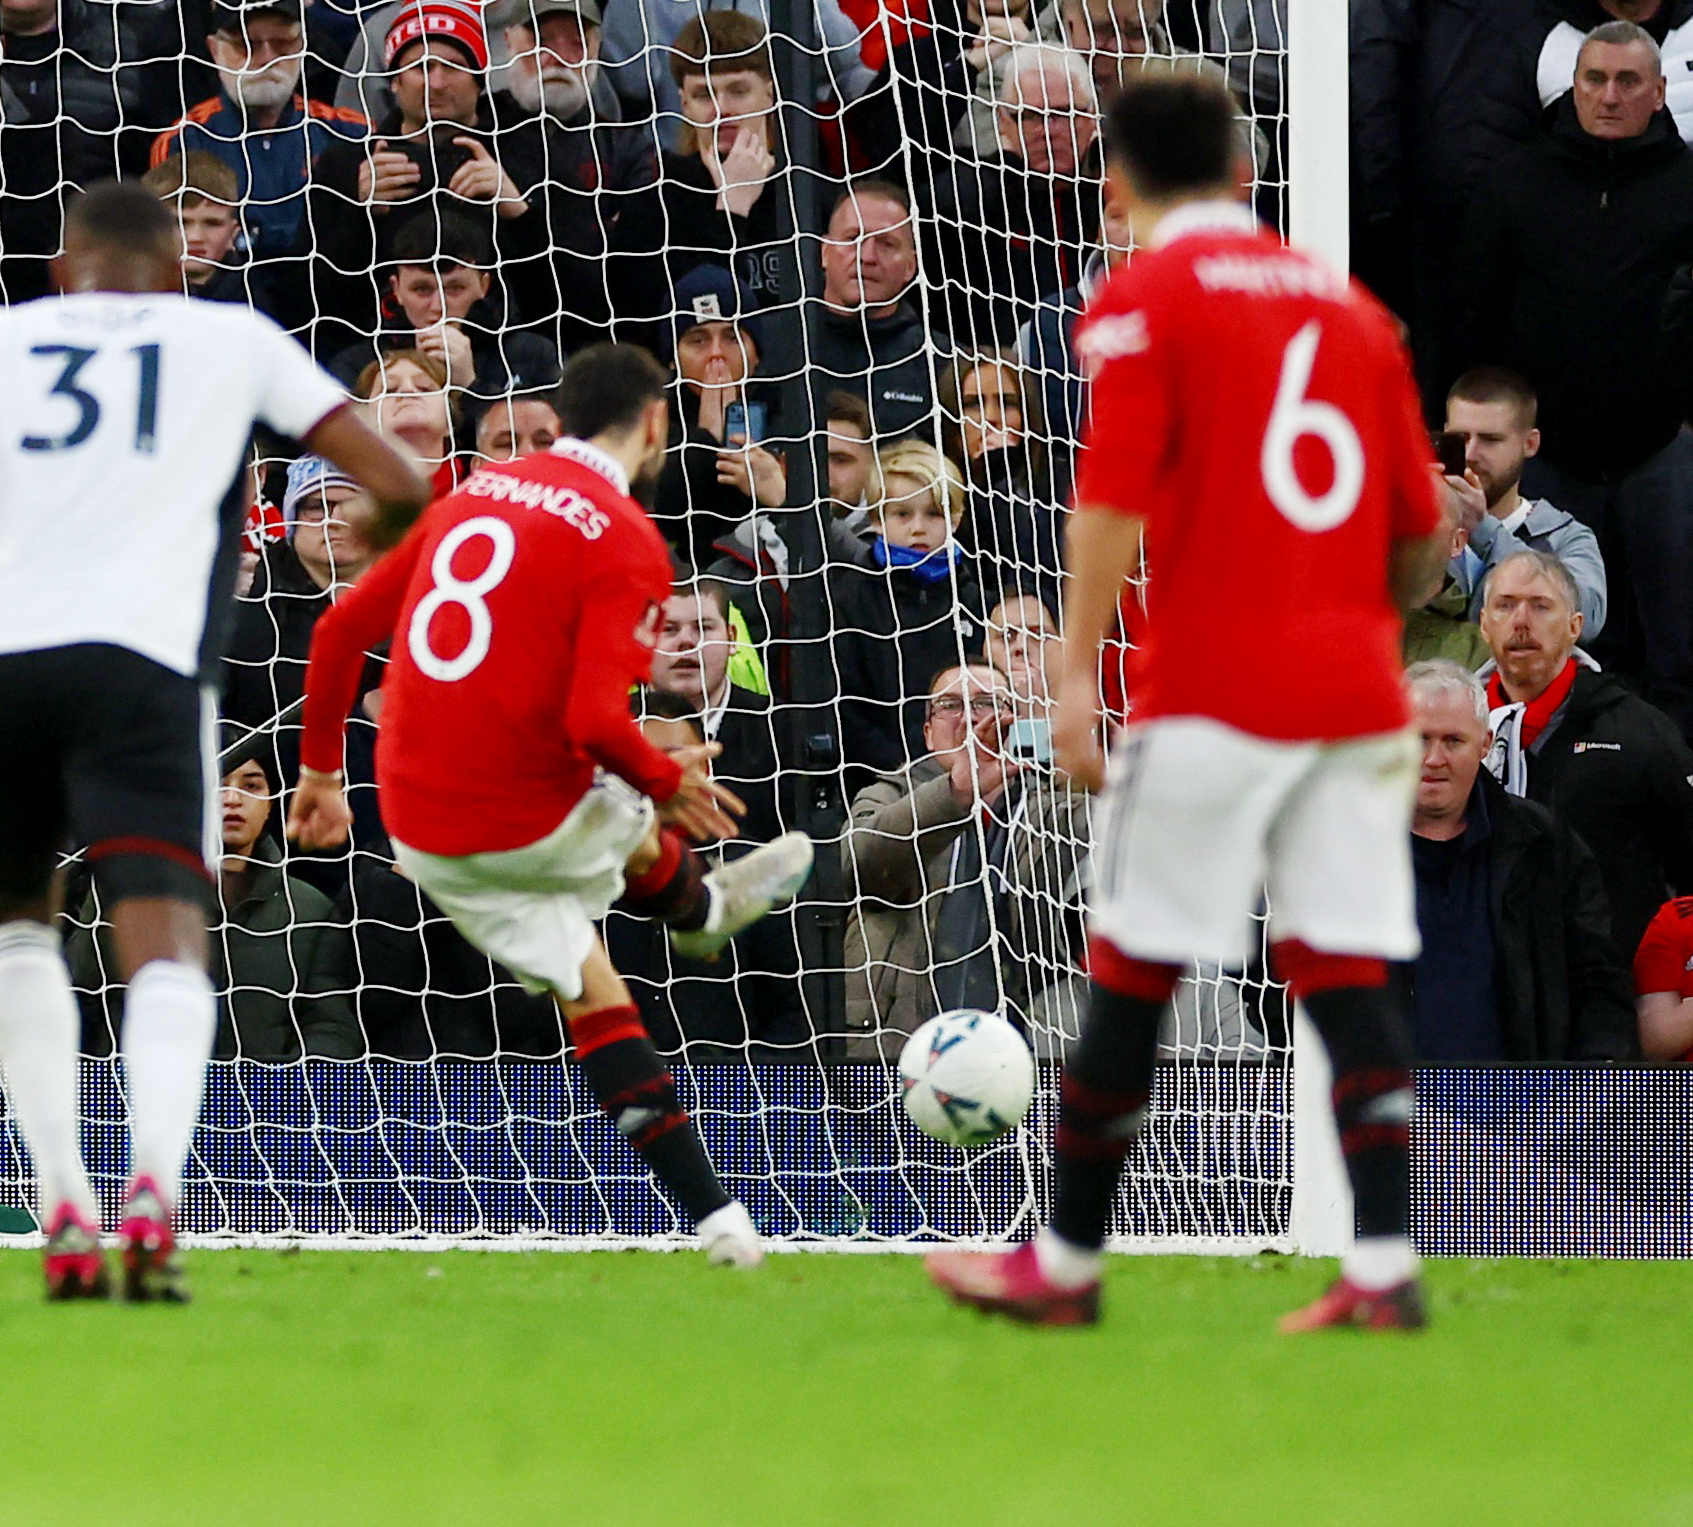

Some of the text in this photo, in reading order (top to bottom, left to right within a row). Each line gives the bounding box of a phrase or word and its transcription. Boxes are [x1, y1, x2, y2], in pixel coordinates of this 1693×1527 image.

[21, 344, 160, 451] 31
[1261, 318, 1365, 532] 6
[468, 470, 611, 540] FERNANDES
[408, 516, 516, 682] 8
